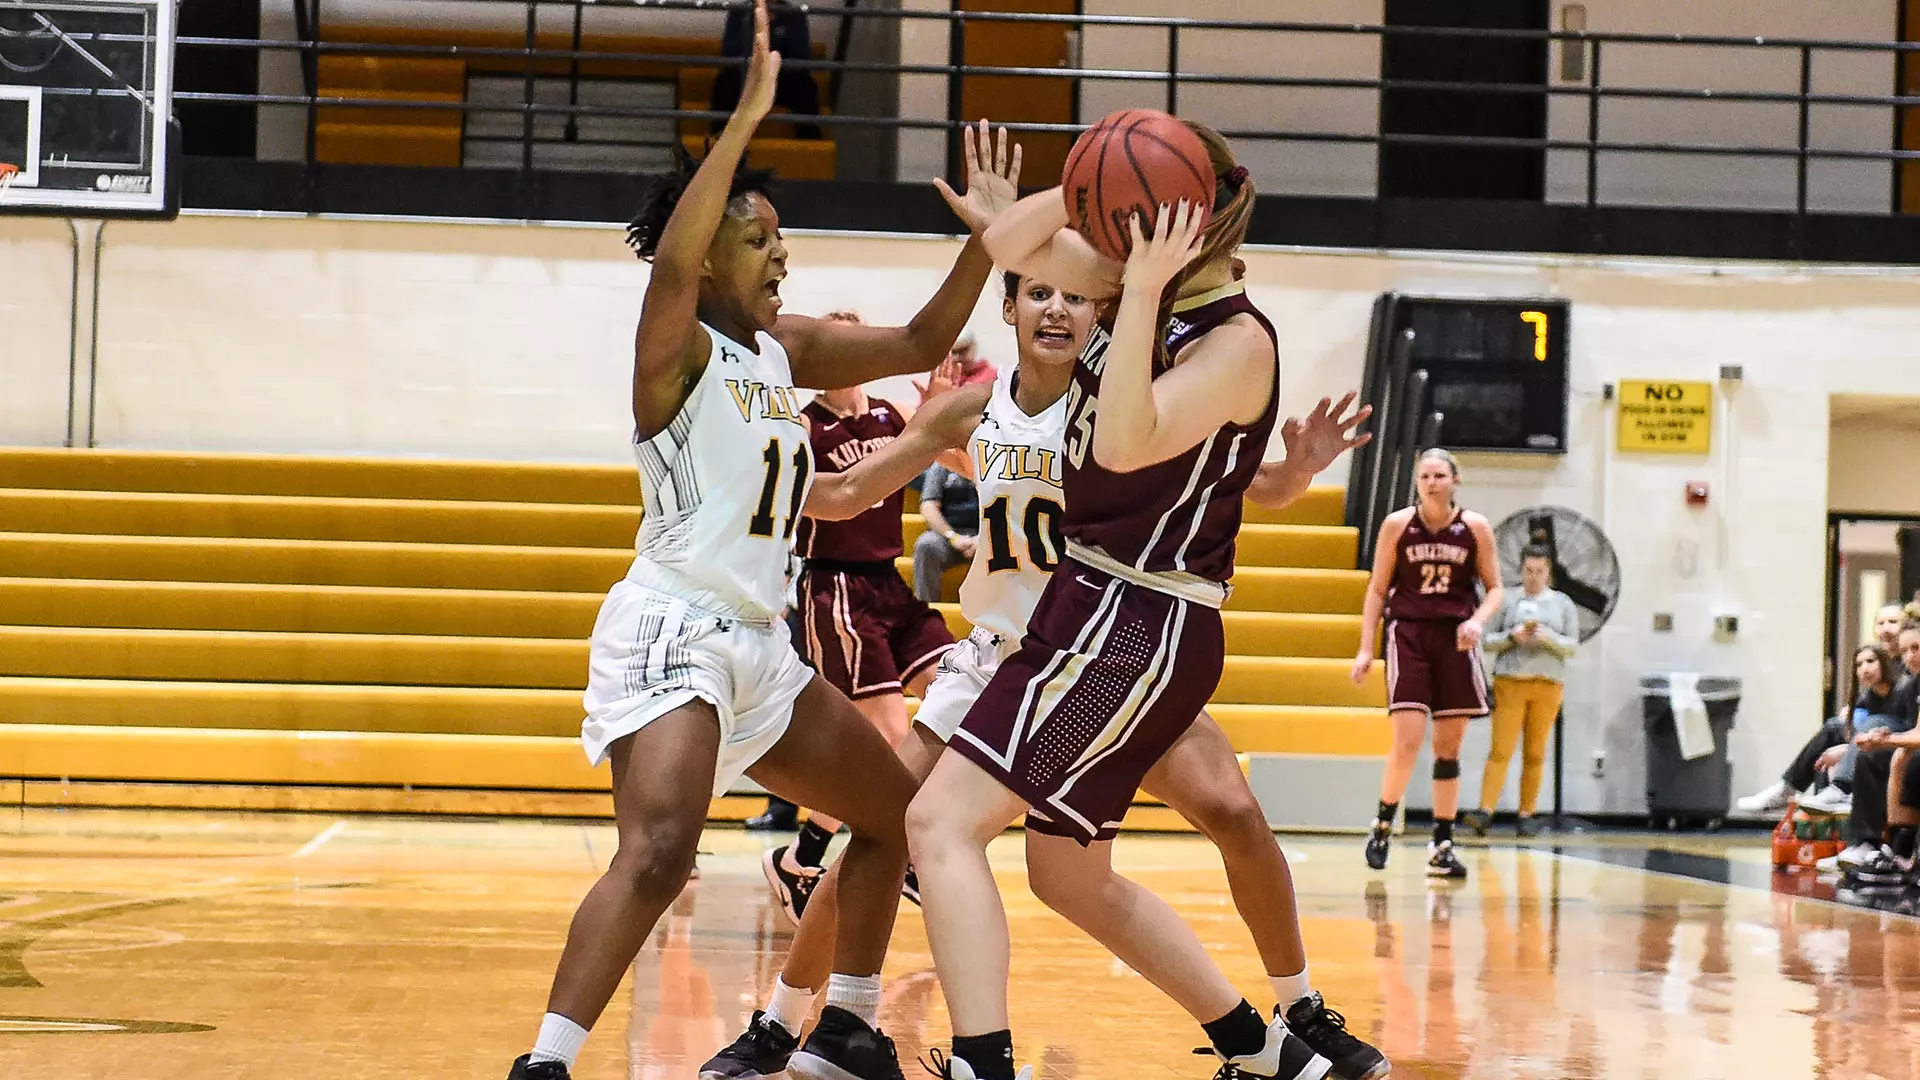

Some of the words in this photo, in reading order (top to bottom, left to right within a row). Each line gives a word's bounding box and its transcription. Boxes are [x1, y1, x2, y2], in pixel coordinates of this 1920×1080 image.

[1520, 311, 1547, 361] 7
[725, 378, 804, 428] VILL
[1645, 384, 1683, 400] NO
[749, 437, 809, 540] 11
[977, 438, 1063, 489] VILL
[982, 494, 1066, 575] 10
[1420, 563, 1451, 594] 23
